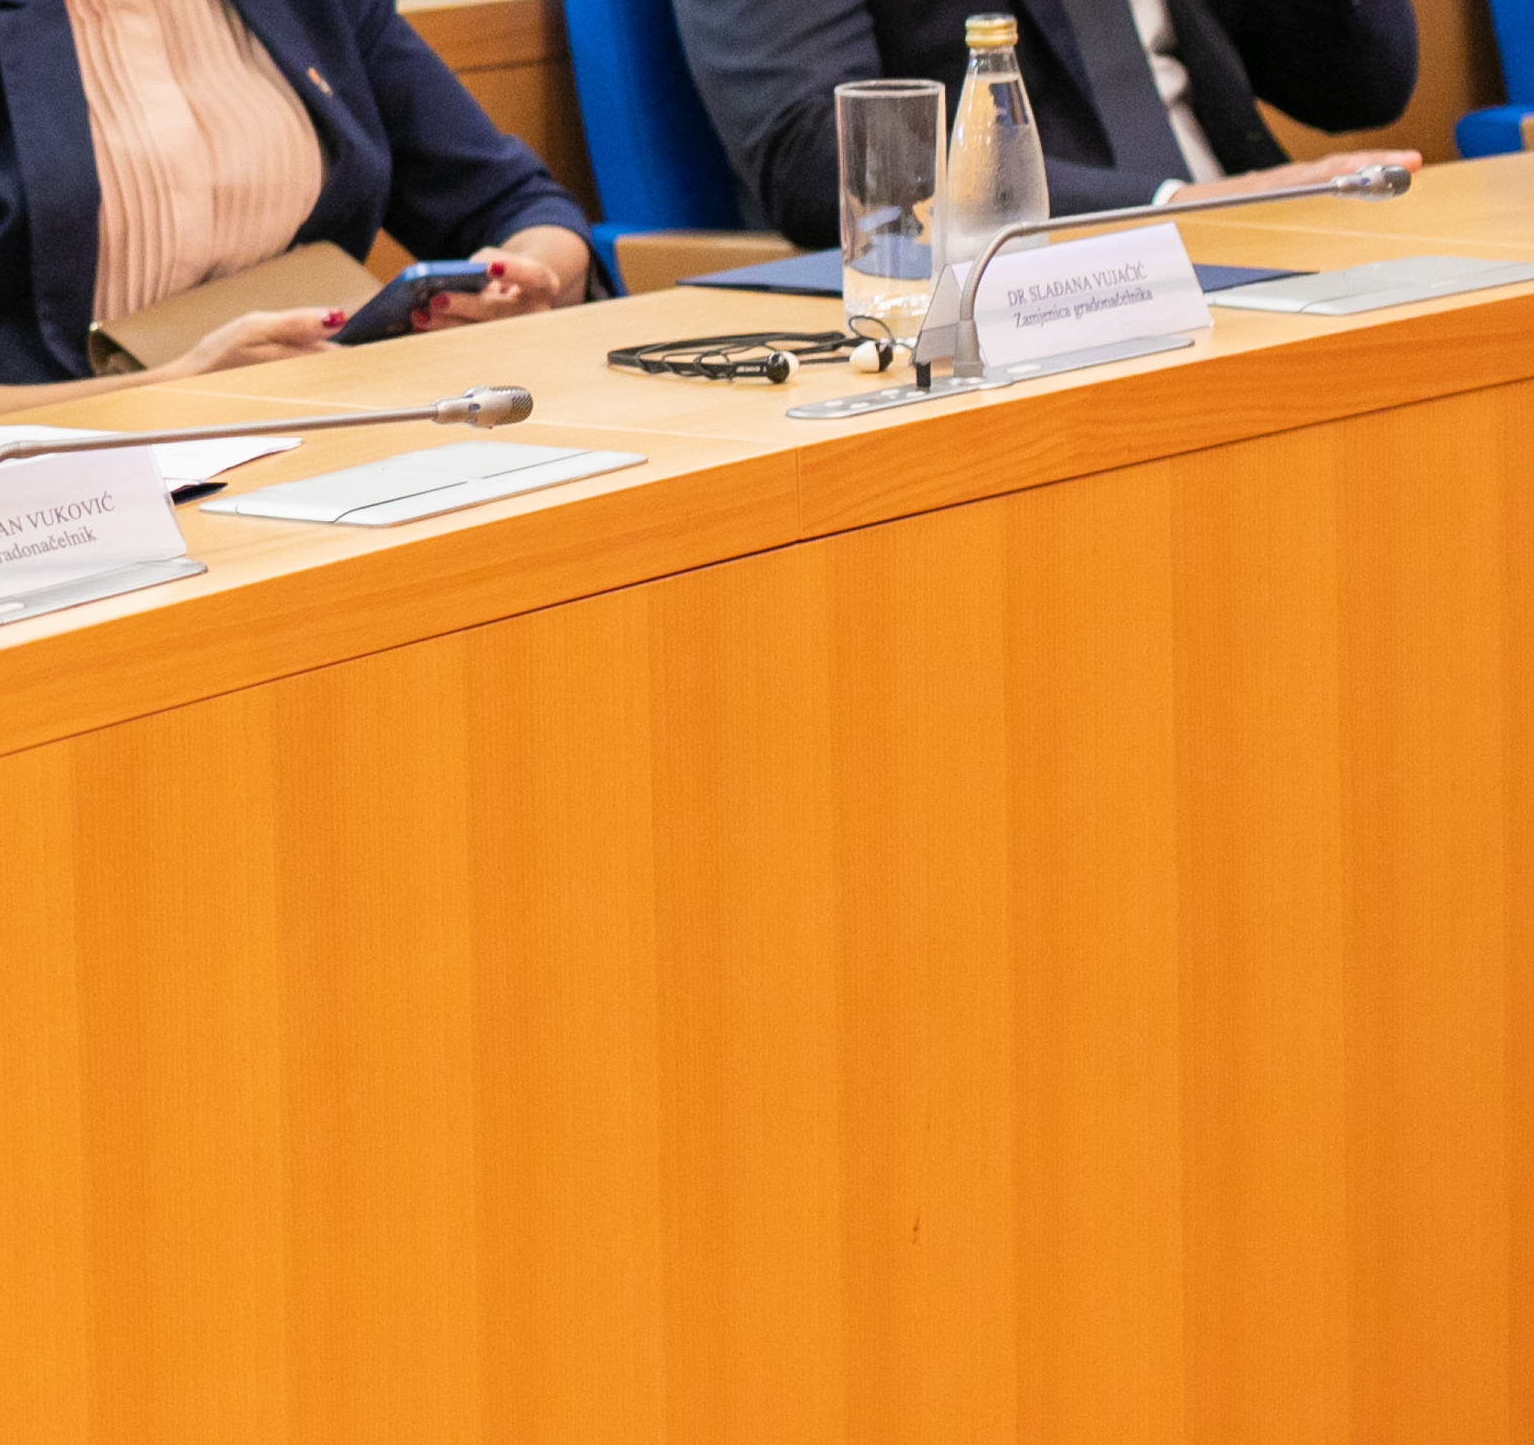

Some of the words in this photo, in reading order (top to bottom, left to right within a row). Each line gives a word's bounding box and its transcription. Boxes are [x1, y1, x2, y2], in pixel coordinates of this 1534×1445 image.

[1007, 289, 1028, 307] DR
[1028, 275, 1092, 302] SLAĐANA
[1013, 305, 1072, 329] Zamjenica
[26, 490, 116, 528] VUKOVIĆ
